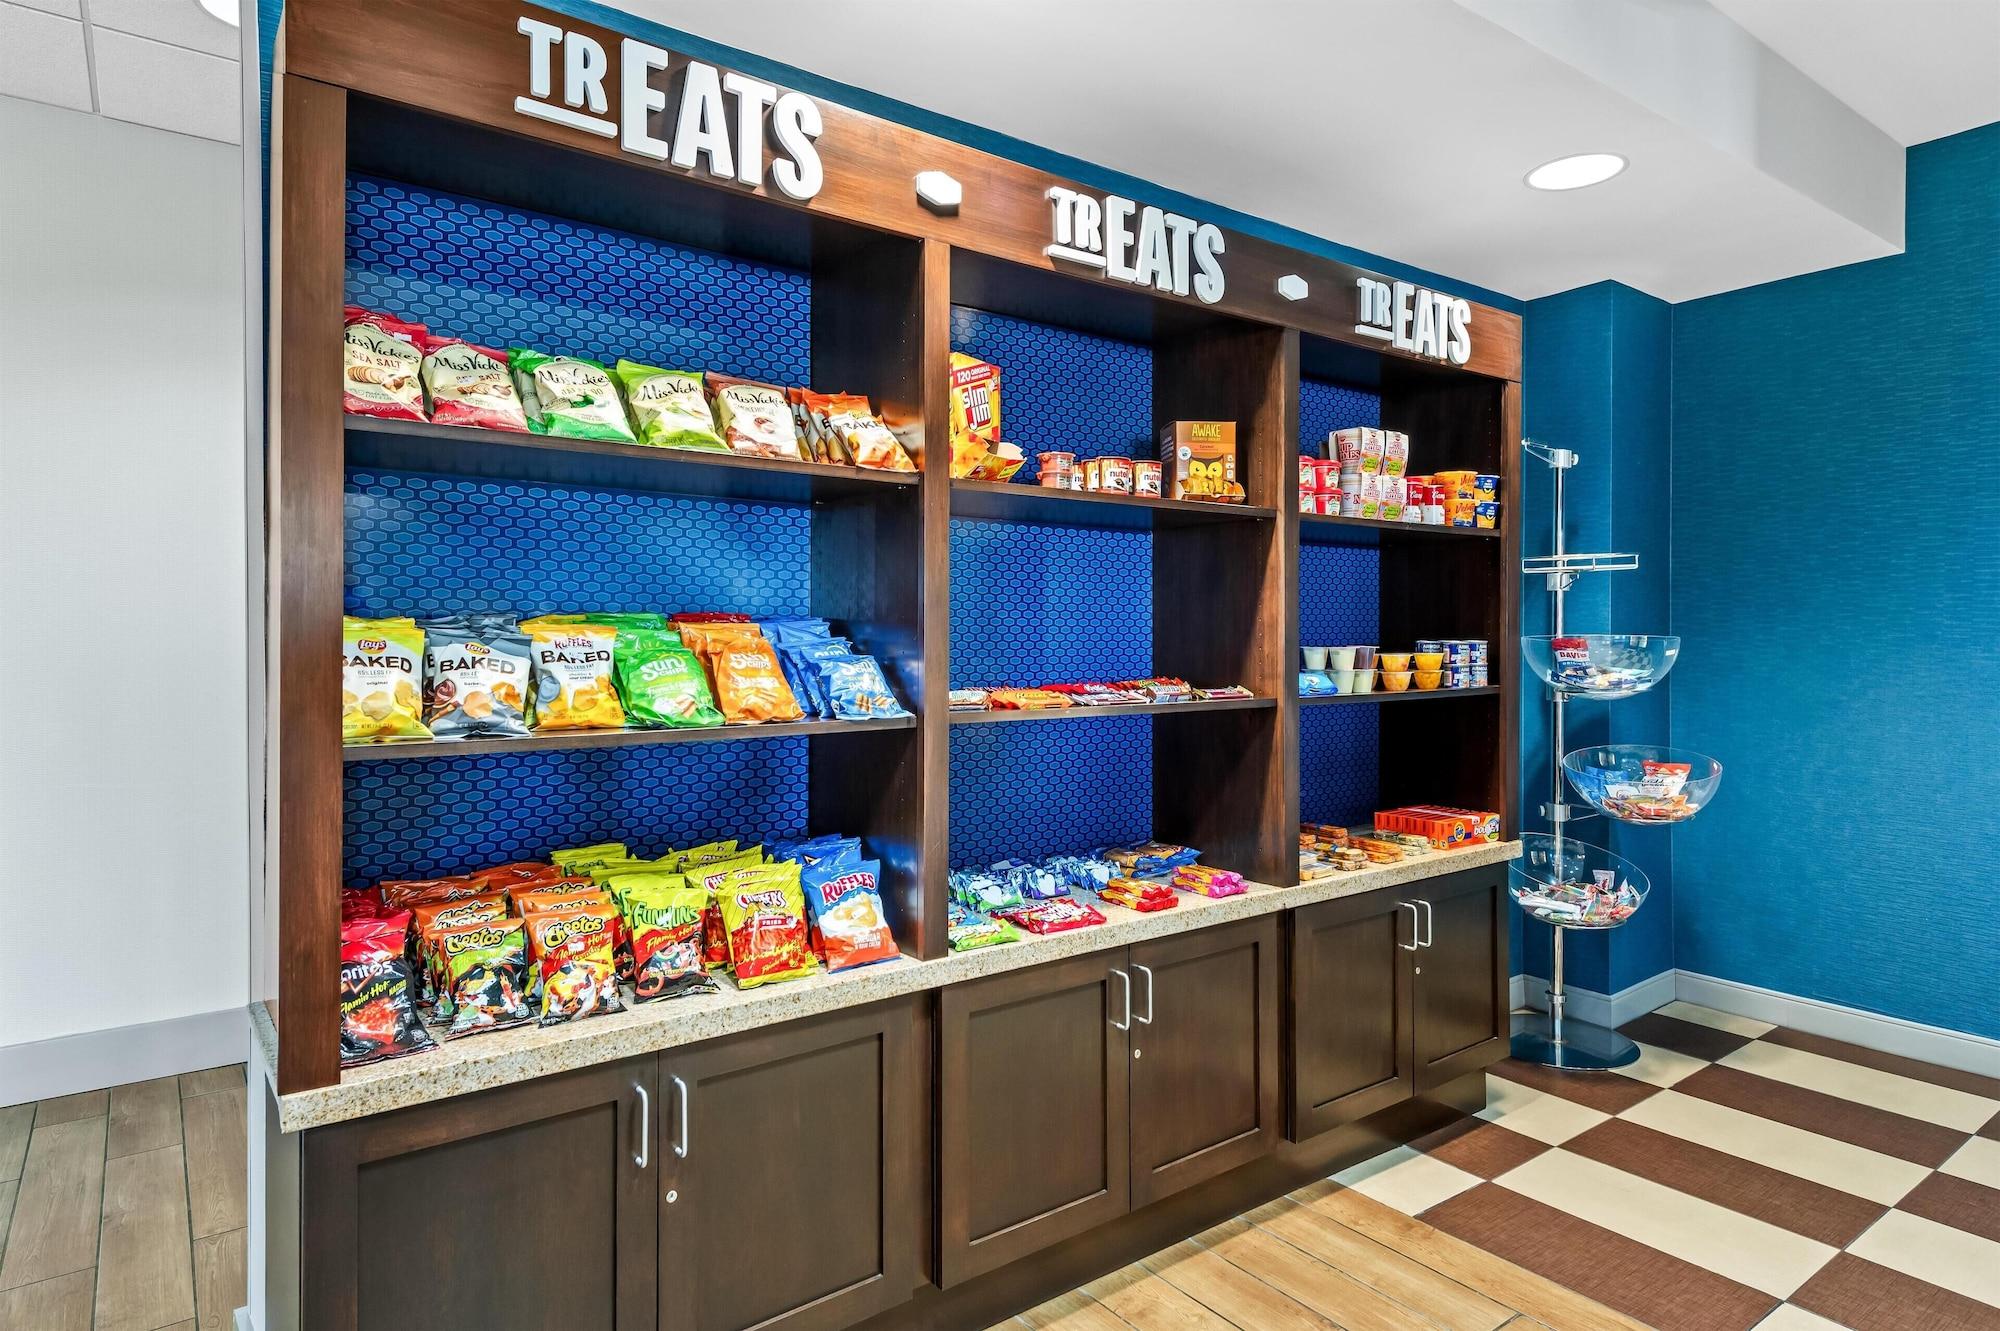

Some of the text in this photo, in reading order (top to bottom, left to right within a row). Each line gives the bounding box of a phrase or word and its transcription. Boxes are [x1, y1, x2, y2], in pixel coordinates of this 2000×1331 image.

[515, 15, 824, 201] TREATS
[1048, 186, 1226, 305] TREATS
[1355, 277, 1472, 366] TREATS
[352, 350, 402, 369] SEA SALT
[956, 370, 971, 384] 120
[1191, 423, 1221, 438] AWAKE
[554, 637, 593, 650] RUFFLES
[440, 656, 516, 675] BAKED
[821, 872, 876, 905] RUFFLES
[445, 927, 504, 955] Cheetos
[544, 915, 604, 949] Cheetos
[341, 960, 394, 981] oritos
[370, 980, 390, 998] Hot
